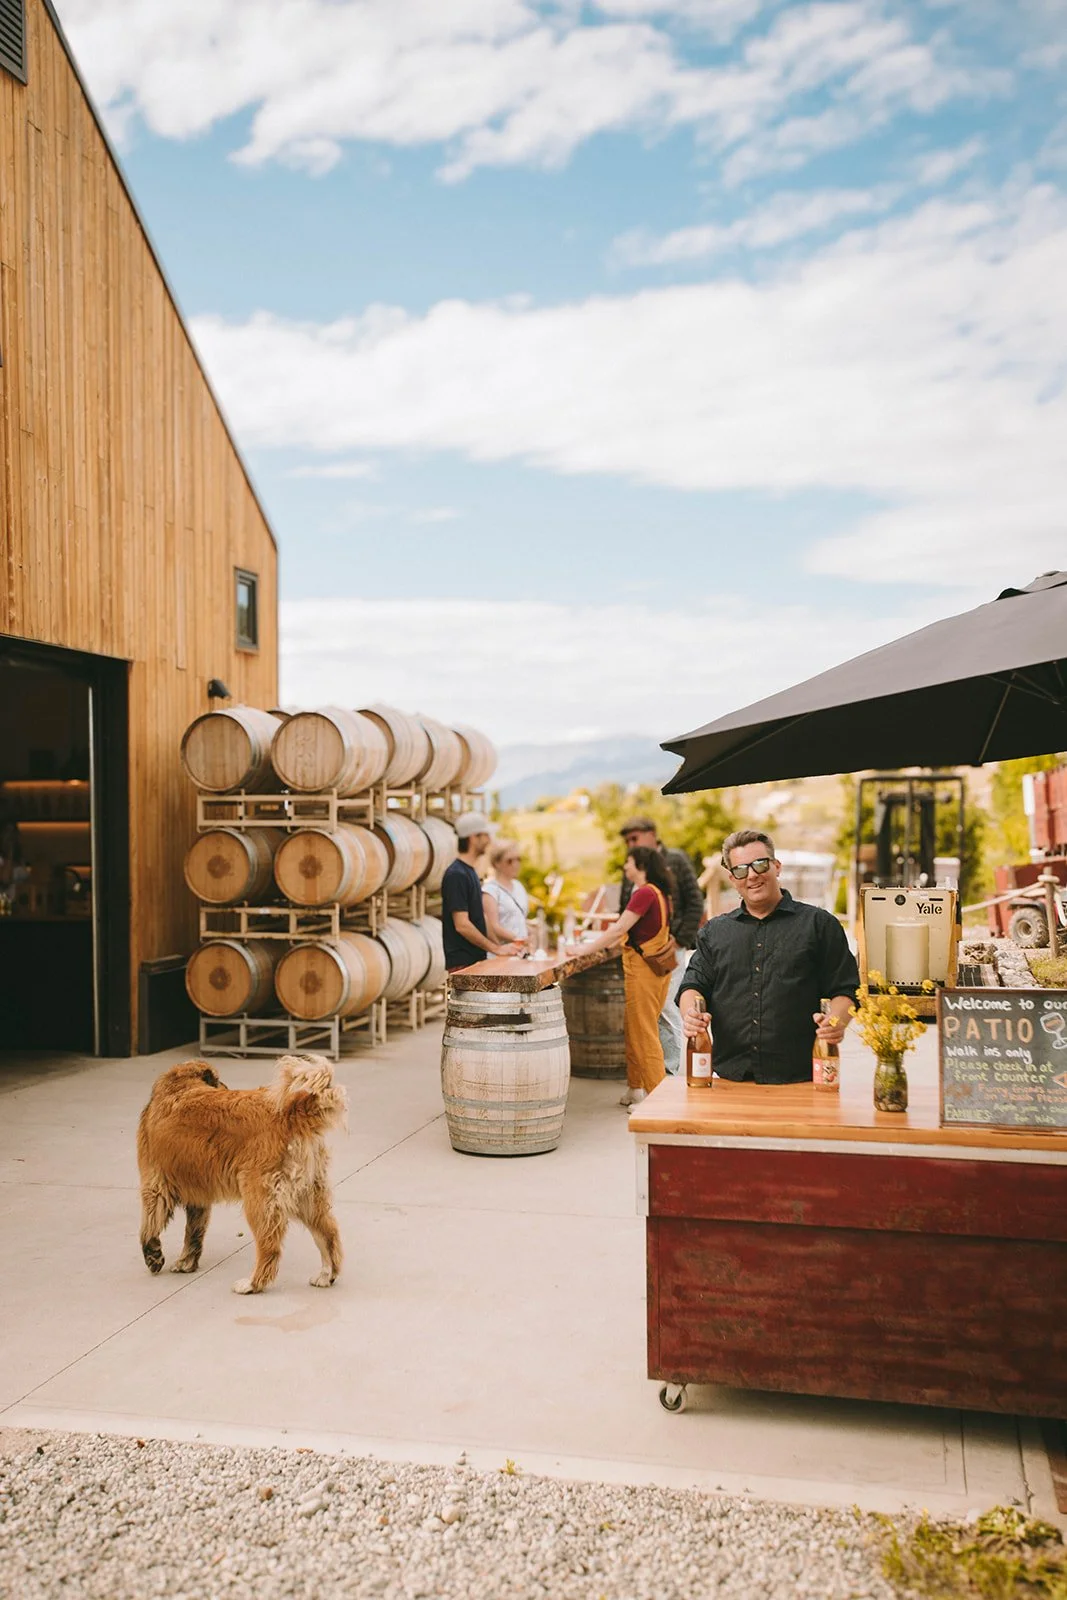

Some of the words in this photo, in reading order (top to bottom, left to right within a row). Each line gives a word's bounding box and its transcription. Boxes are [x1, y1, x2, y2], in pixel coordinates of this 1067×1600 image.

[916, 903, 943, 915] Yale
[944, 996, 1013, 1011] Welcome
[1018, 998, 1035, 1010] to
[943, 1015, 1034, 1044] PATIO
[945, 1045, 979, 1057] Walk
[984, 1045, 1002, 1057] ins
[1005, 1047, 1033, 1065] only
[944, 1058, 990, 1071] Please
[993, 1060, 1022, 1072] check
[1039, 1061, 1055, 1074] at
[953, 1070, 989, 1082] front
[994, 1072, 1048, 1084] counter
